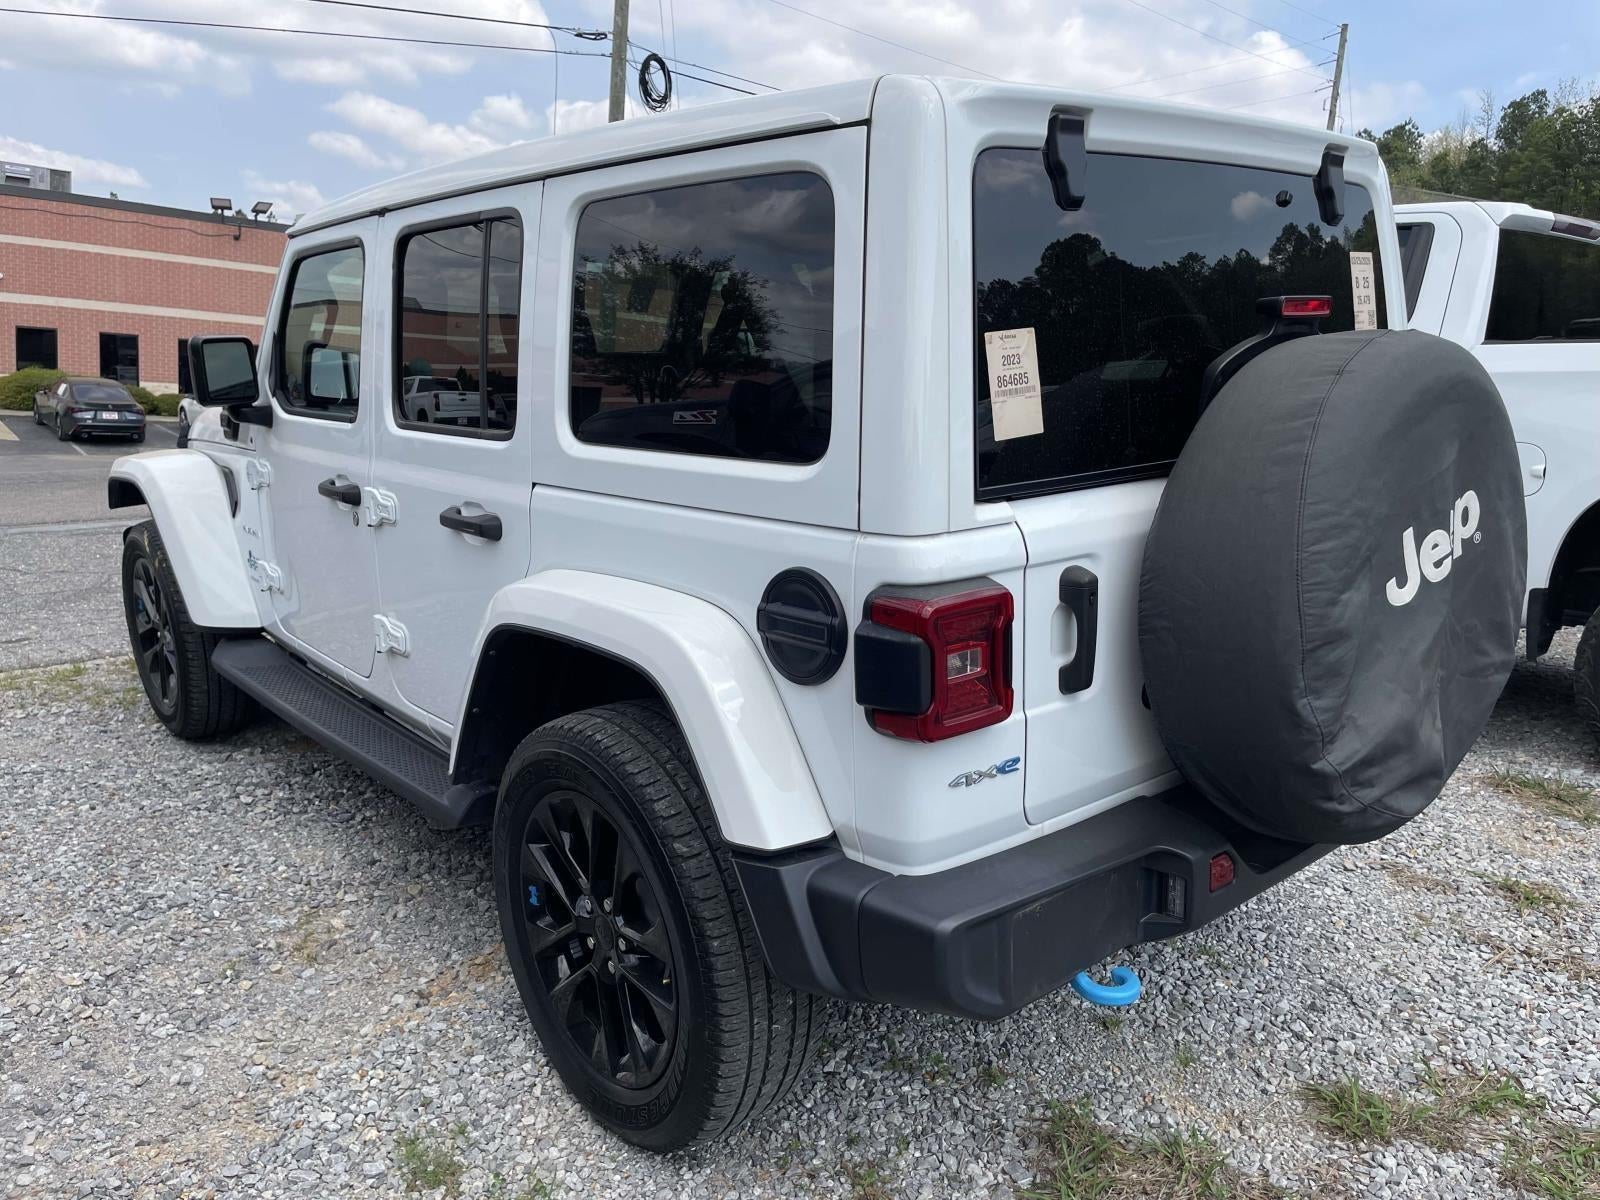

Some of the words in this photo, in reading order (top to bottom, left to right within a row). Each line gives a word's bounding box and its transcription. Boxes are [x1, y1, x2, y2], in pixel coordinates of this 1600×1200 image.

[1001, 353, 1021, 366] 2023
[996, 372, 1029, 388] 864685
[1386, 490, 1480, 606] Jep
